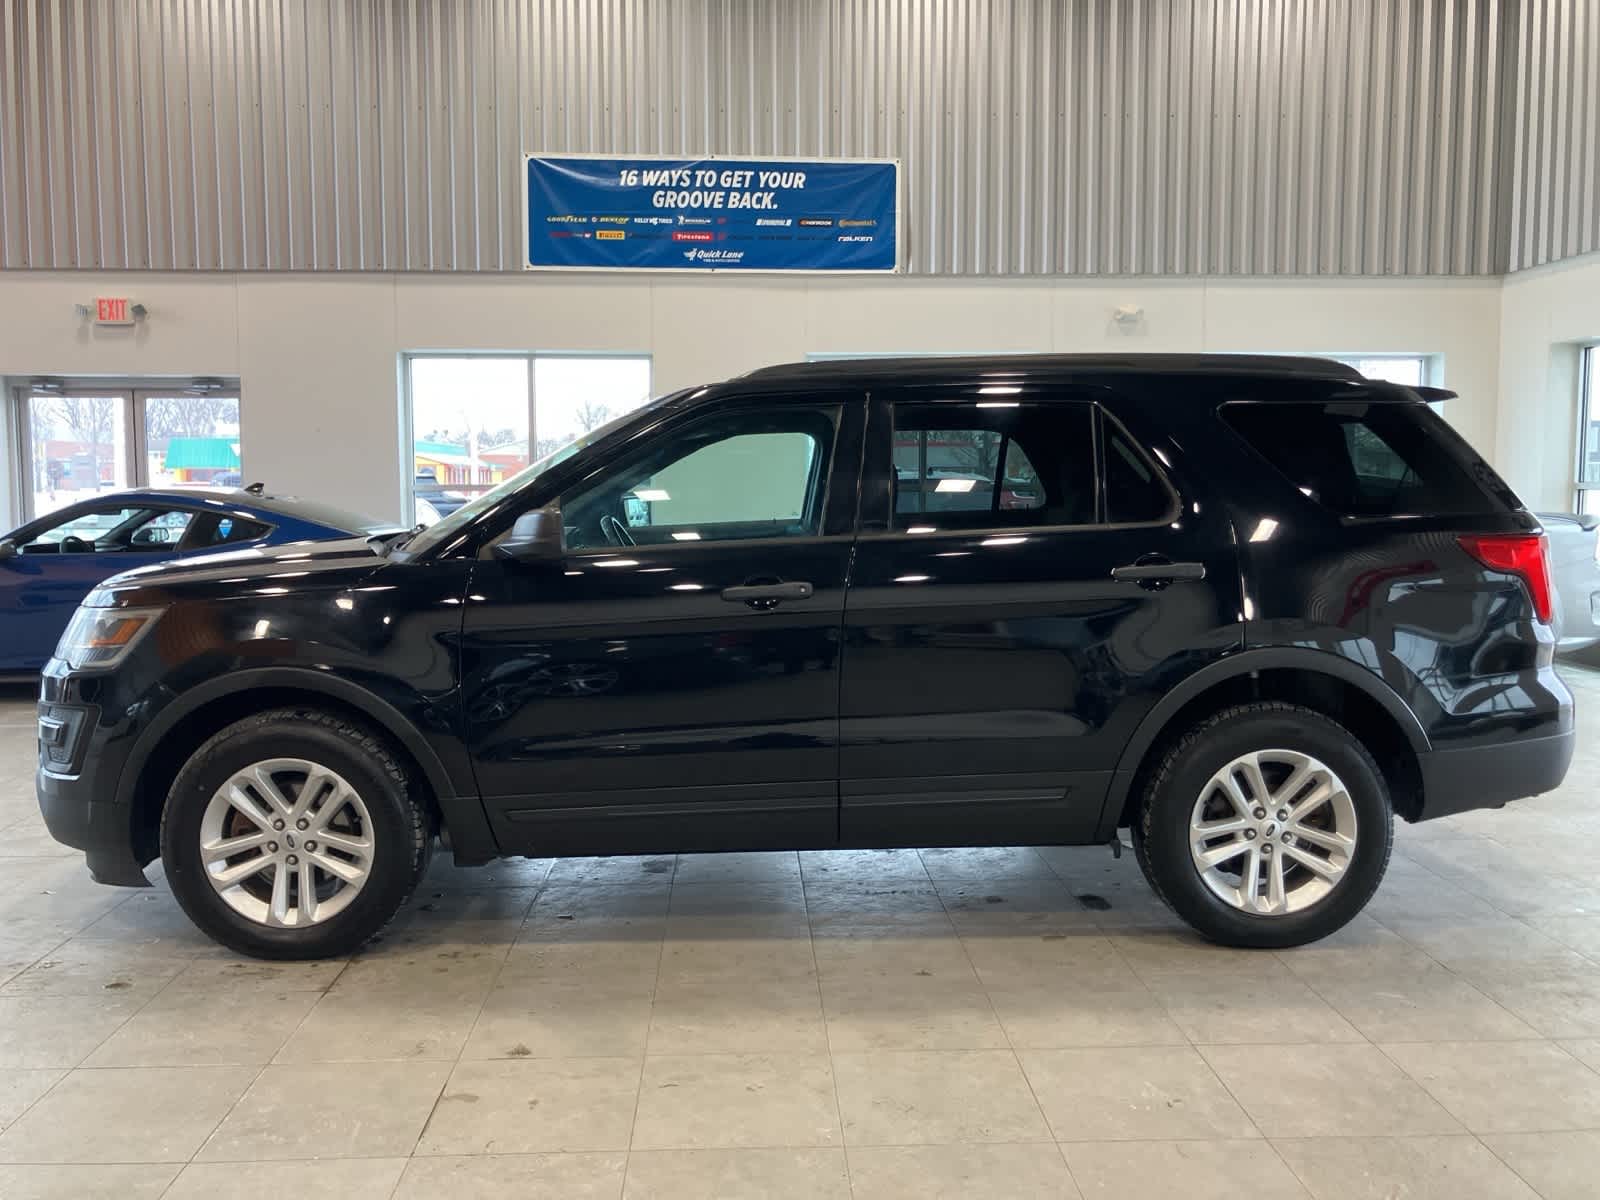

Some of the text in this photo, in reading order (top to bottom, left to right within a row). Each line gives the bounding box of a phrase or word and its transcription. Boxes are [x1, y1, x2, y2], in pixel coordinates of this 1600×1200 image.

[619, 170, 806, 189] 16 WAYS TO GET YOUR
[652, 190, 779, 210] GROOVE BACK.
[697, 249, 744, 259] Quick Lane
[98, 298, 128, 321] EXIT
